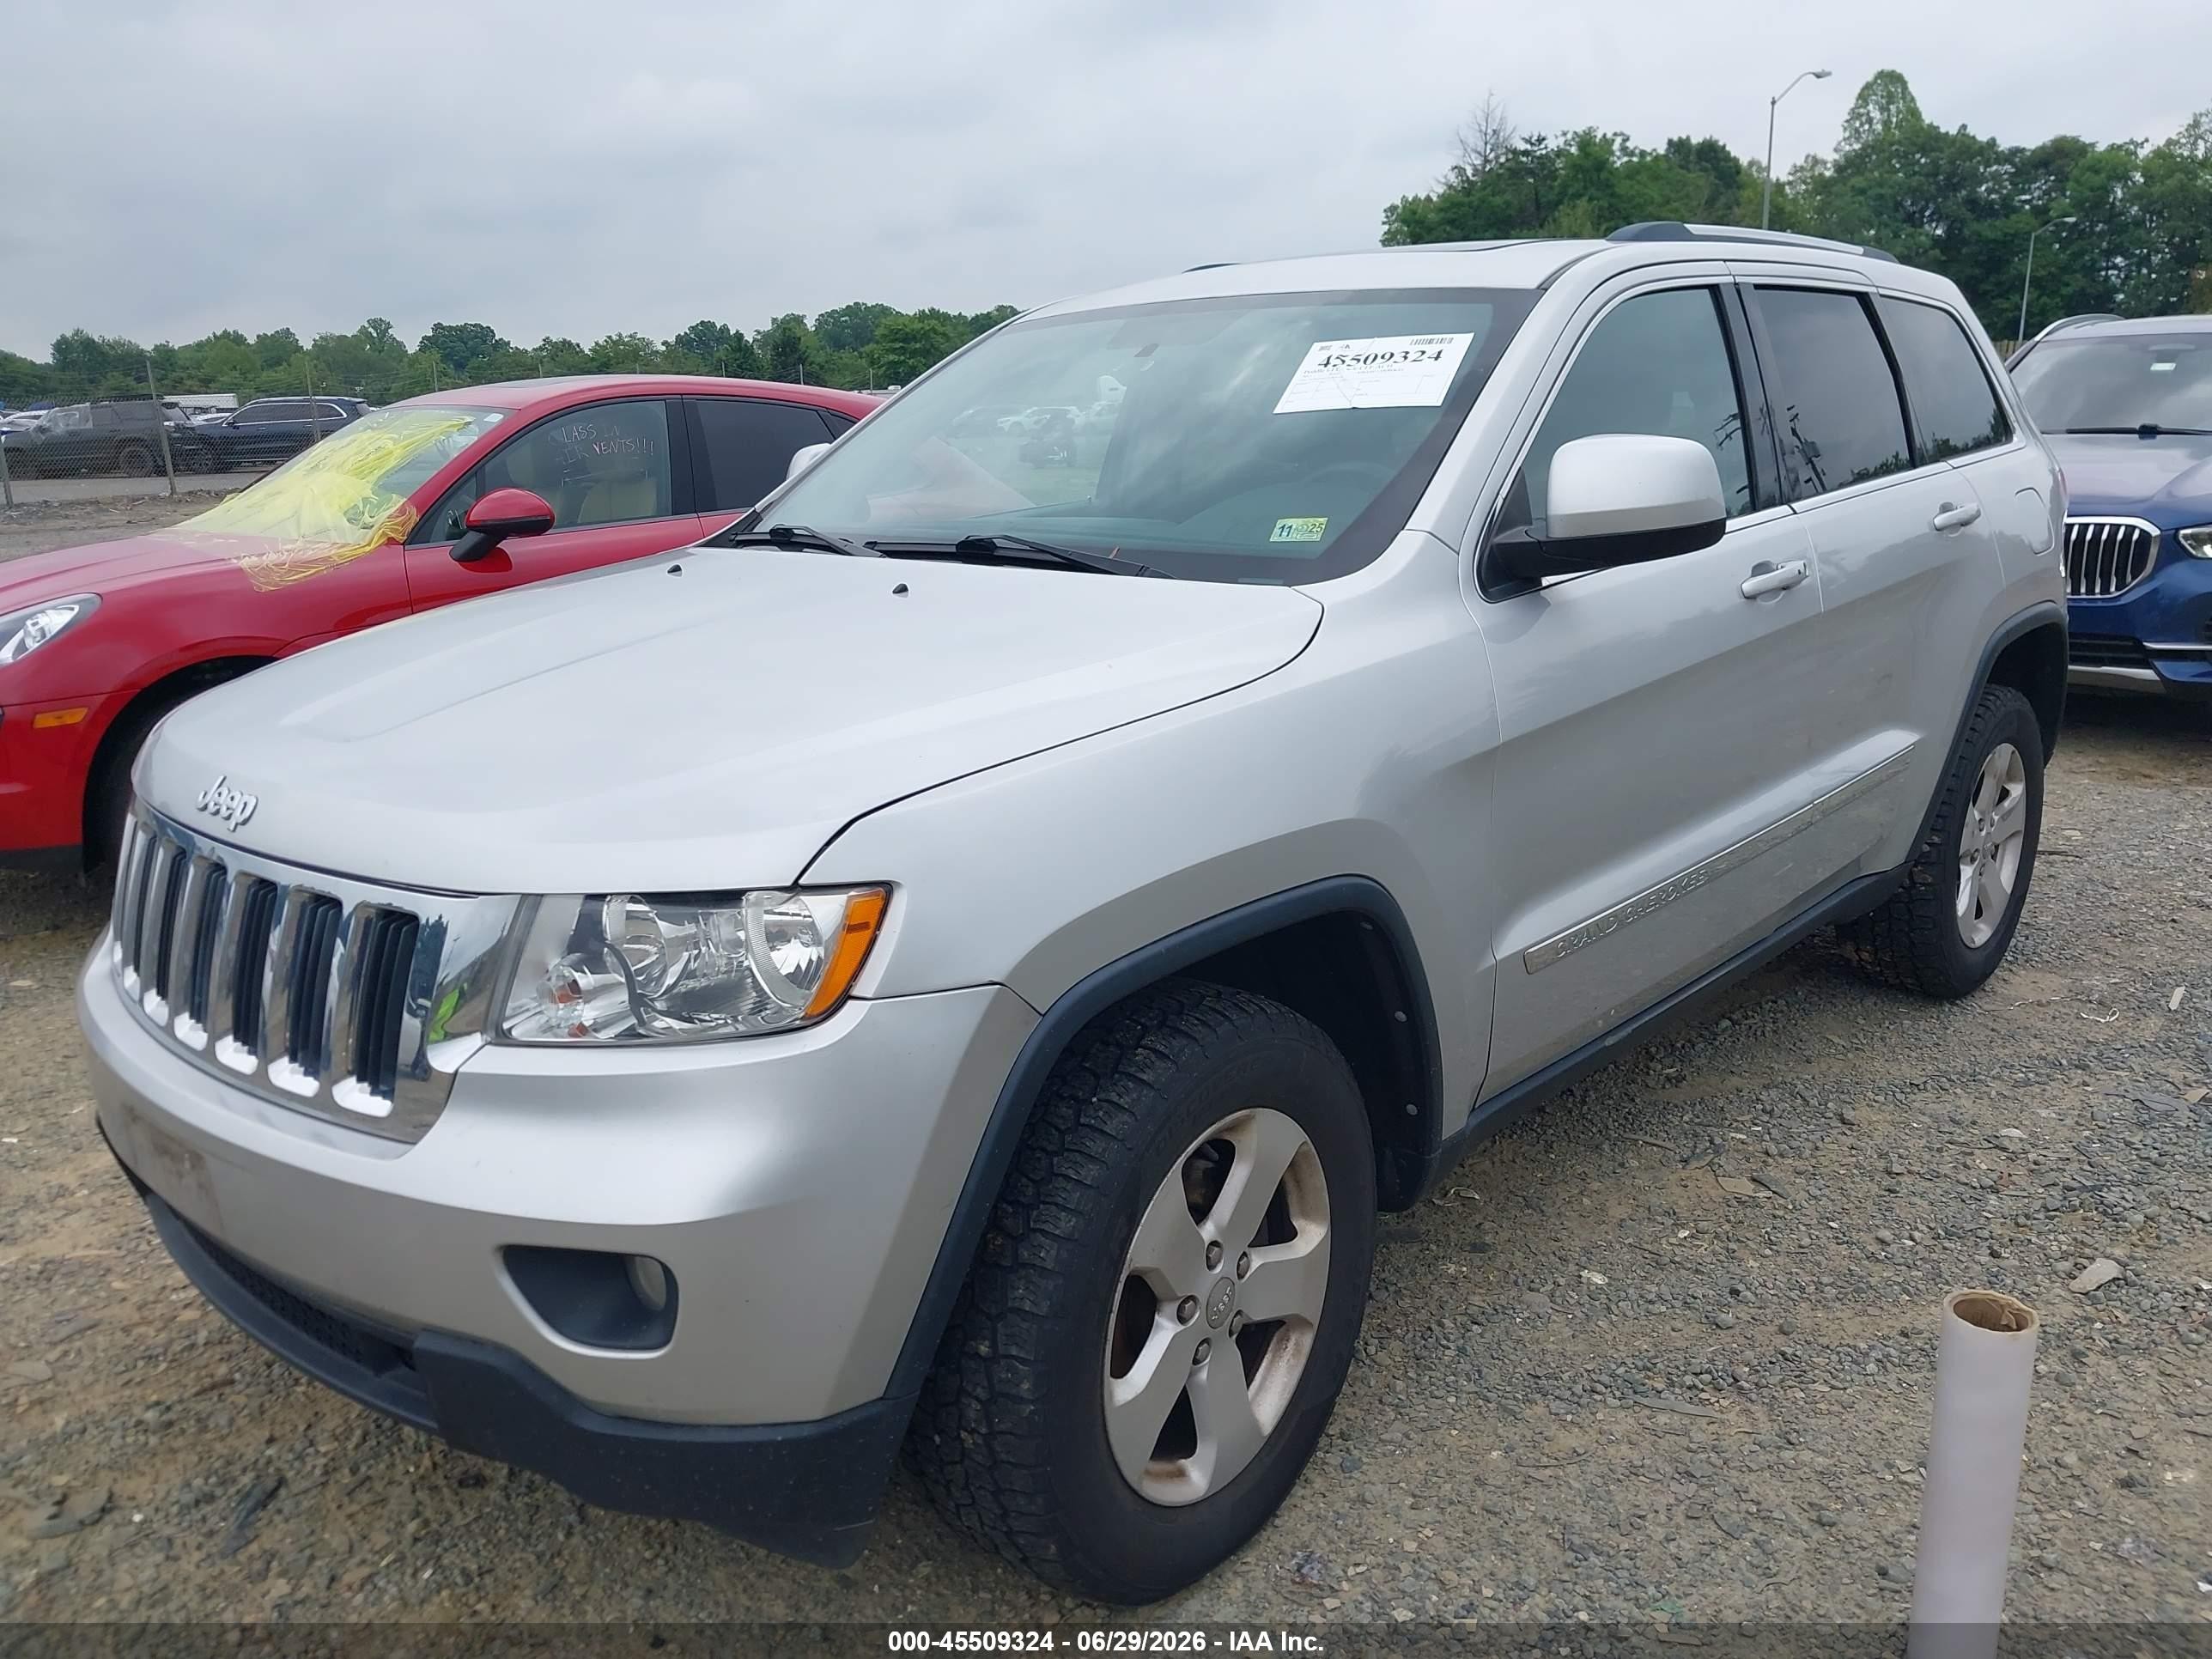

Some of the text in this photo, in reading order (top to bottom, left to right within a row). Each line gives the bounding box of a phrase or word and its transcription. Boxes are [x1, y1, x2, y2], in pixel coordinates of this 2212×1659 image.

[1317, 349, 1444, 368] 45509324
[1278, 524, 1294, 538] 11
[1308, 523, 1325, 533] 25
[197, 775, 259, 833] Jeep
[1556, 869, 1711, 958] GRAND CHEROKEE
